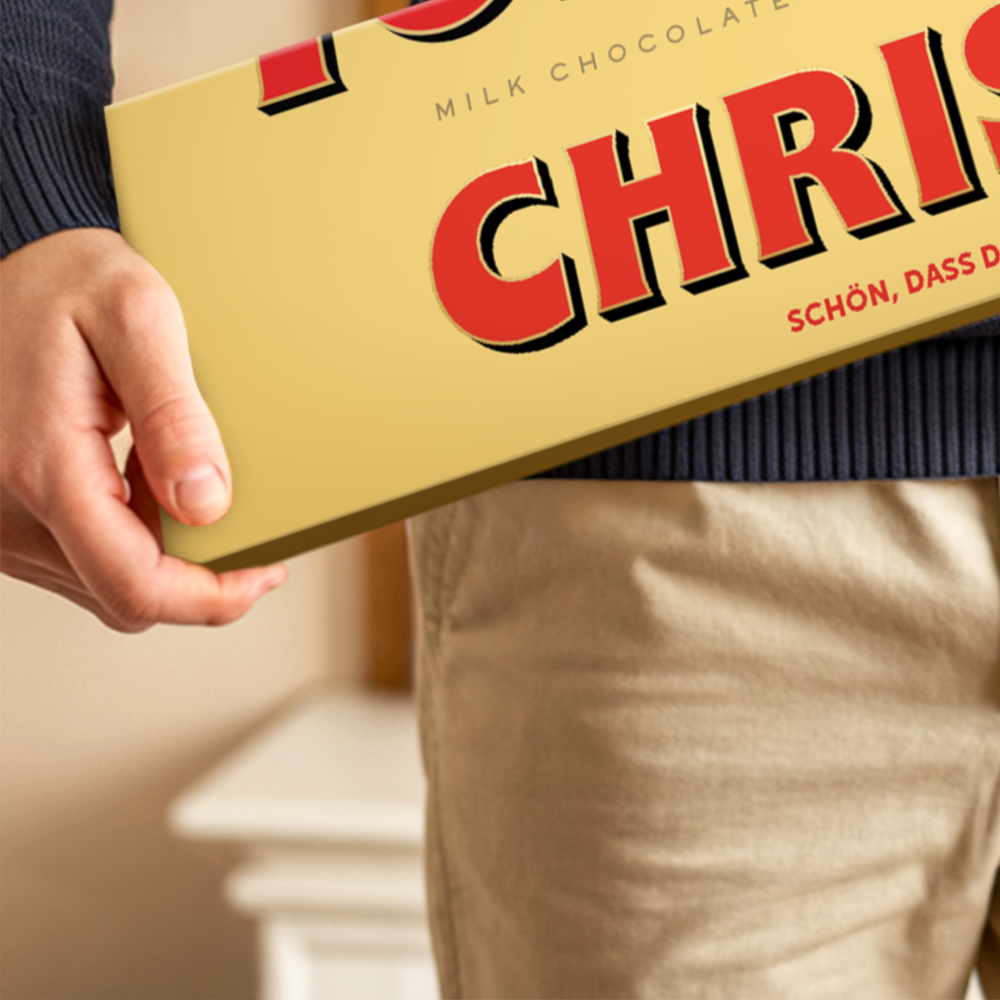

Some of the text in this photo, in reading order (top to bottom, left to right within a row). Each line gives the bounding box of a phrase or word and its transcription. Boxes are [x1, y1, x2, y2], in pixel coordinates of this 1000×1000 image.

[435, 75, 527, 122] MILK
[787, 279, 900, 333] SCHÖN,
[903, 251, 976, 295] DASS
